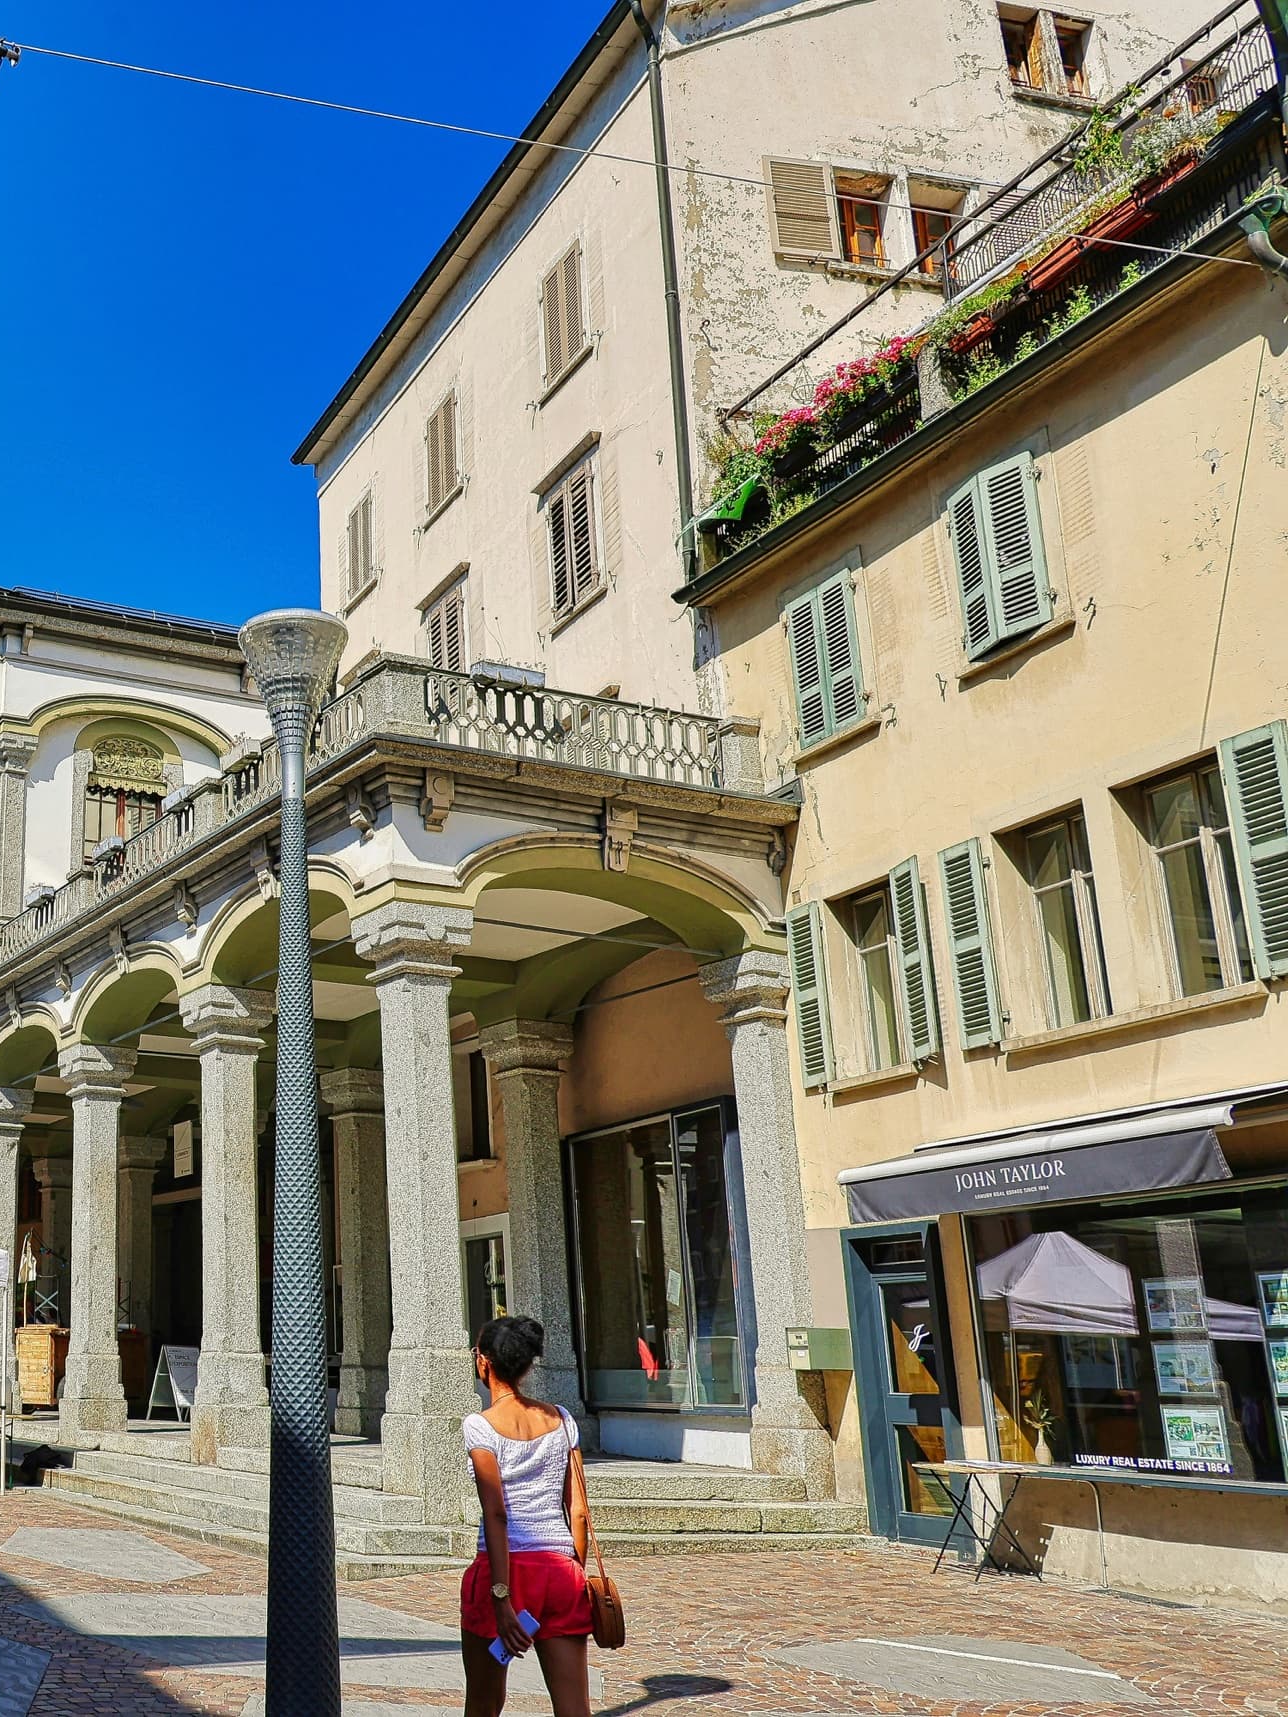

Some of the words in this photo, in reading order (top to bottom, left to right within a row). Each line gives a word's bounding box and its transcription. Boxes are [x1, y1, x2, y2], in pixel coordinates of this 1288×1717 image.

[955, 1170, 997, 1192] JOHN
[1000, 1159, 1066, 1184] TAYLOR
[1075, 1454, 1111, 1465] LUXURY
[1112, 1456, 1137, 1467] REAL
[1138, 1458, 1174, 1470] ESTATE
[1175, 1460, 1205, 1472] SINCE
